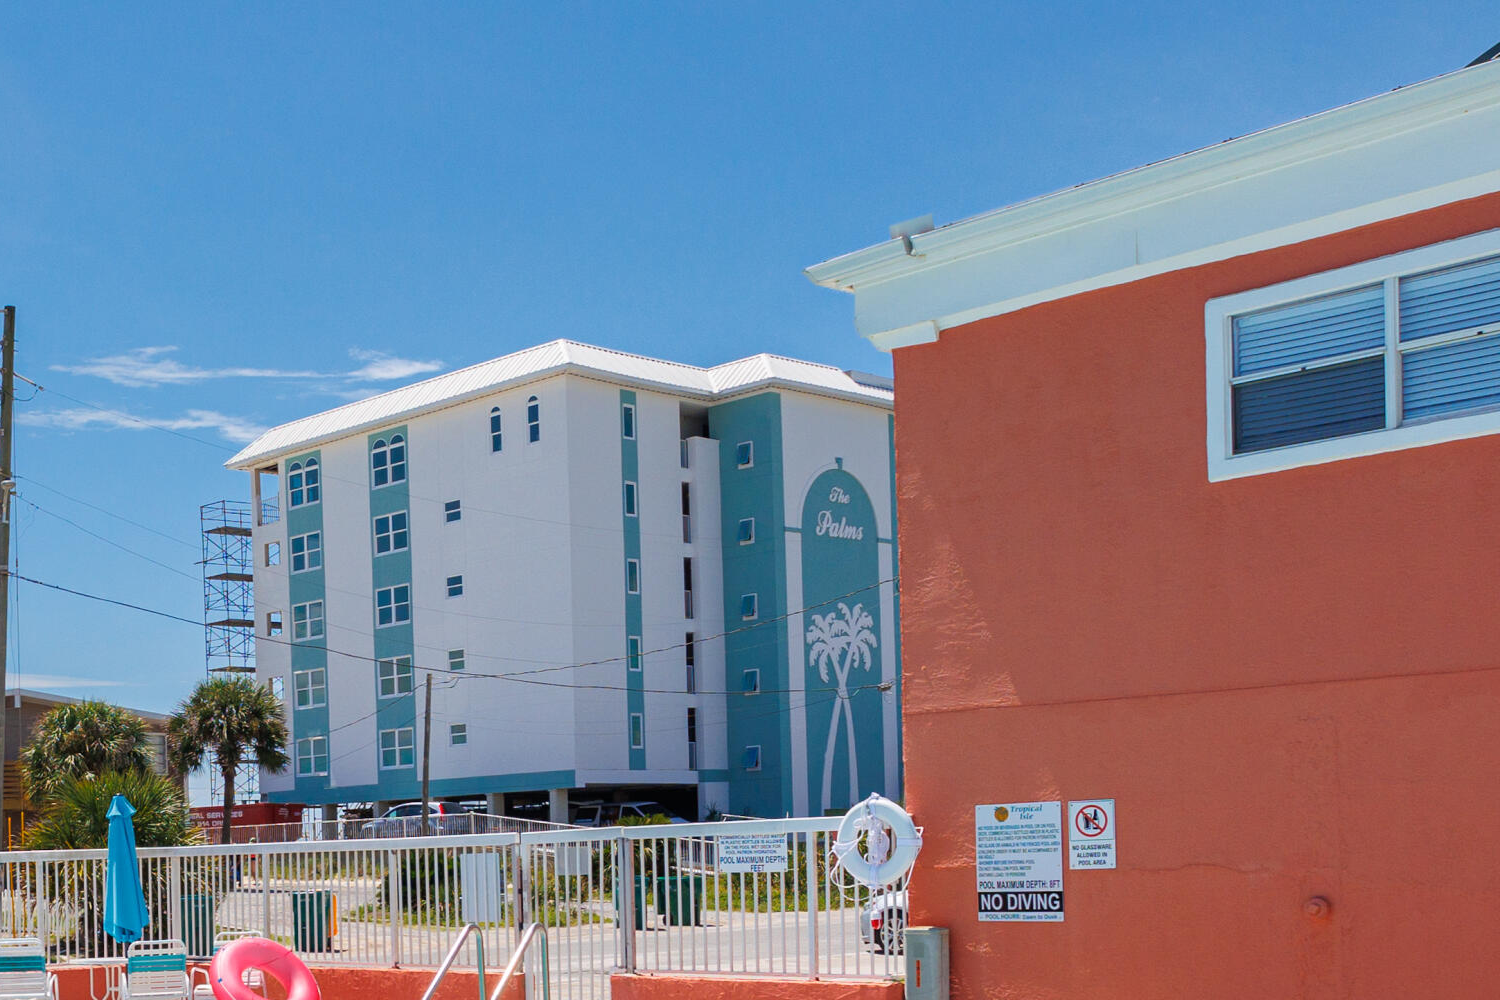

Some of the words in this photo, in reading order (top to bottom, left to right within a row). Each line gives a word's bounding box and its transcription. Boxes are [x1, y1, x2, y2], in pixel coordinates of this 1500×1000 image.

[829, 486, 850, 504] The
[816, 510, 863, 540] Palms
[1011, 804, 1042, 814] Tropical
[979, 881, 995, 889] POOL
[997, 880, 1024, 888] MAXIMUM
[1026, 880, 1047, 888] DEPTH:
[981, 894, 1003, 910] NO
[1007, 893, 1060, 910] DIVING
